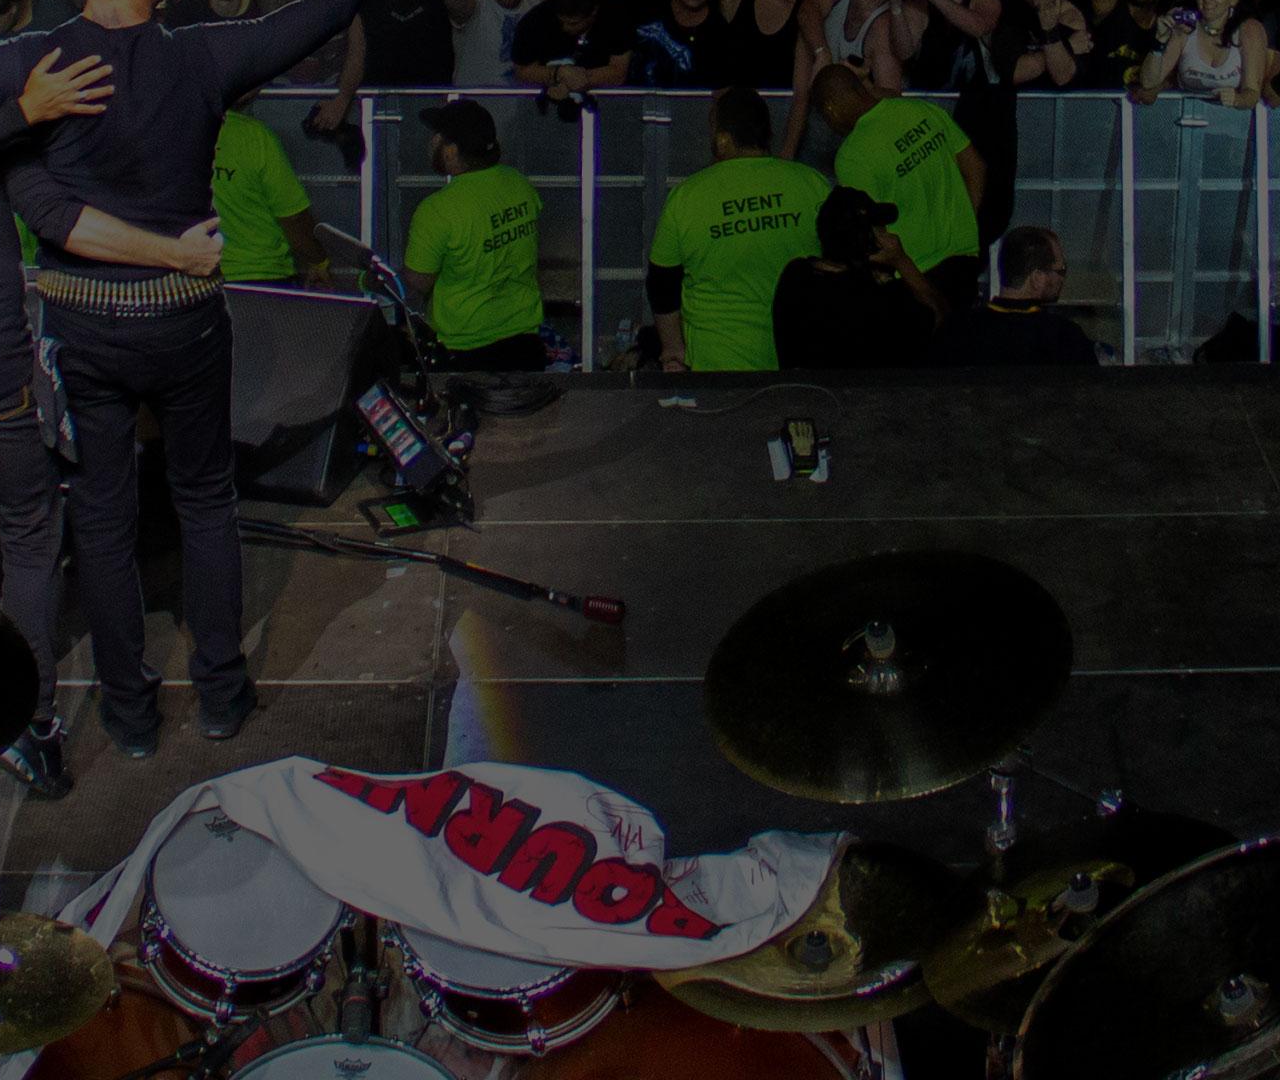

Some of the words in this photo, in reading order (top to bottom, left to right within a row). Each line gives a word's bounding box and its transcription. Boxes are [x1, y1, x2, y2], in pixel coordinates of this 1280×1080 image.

[894, 119, 932, 154] EVENT
[895, 131, 948, 178] SECURITY
[491, 201, 528, 229] EVENT
[722, 193, 784, 217] EVENT
[710, 212, 802, 239] SECURITY
